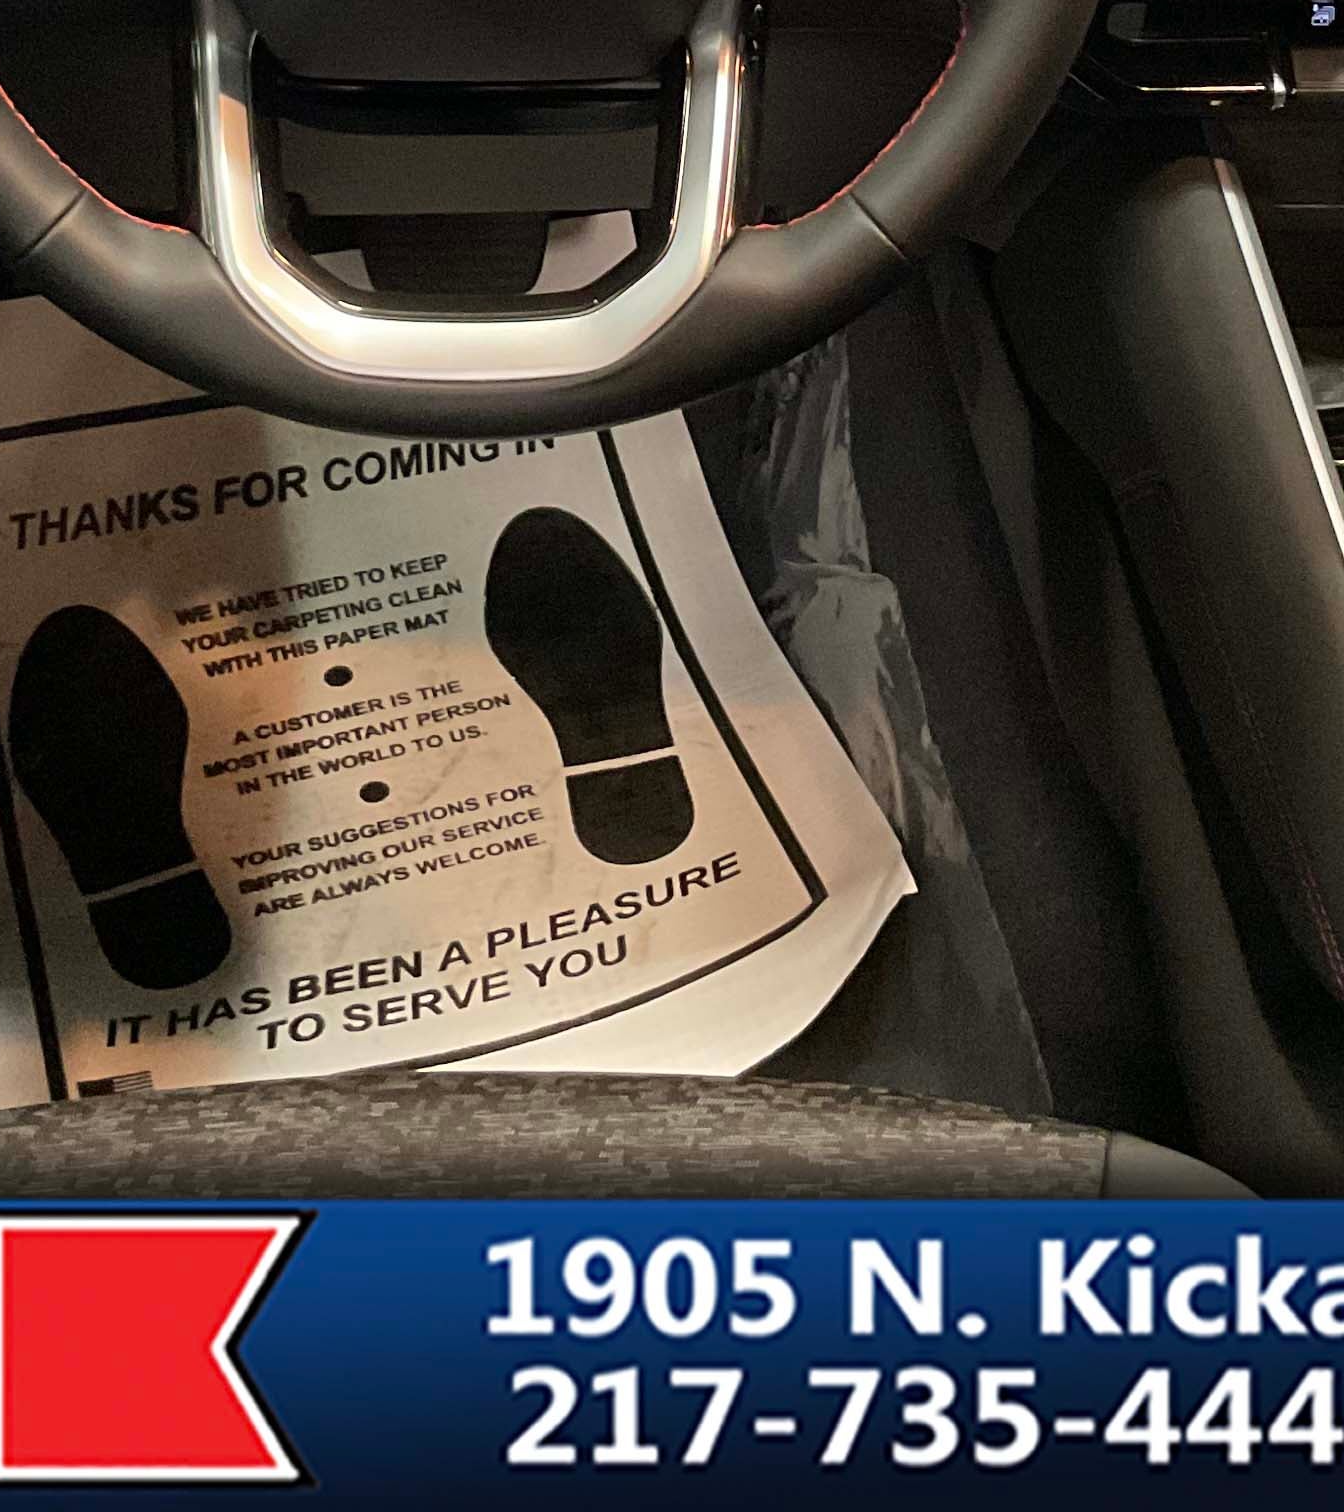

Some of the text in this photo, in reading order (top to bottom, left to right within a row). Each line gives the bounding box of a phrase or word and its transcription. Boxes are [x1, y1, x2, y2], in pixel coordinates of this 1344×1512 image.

[9, 483, 200, 550] THANKS
[214, 465, 309, 515] FOR
[323, 440, 500, 492] COMING
[176, 553, 448, 626] WE HAVE TRIED TO KEEP
[182, 579, 463, 653] YOUR CARPETING CLEAN
[203, 610, 450, 677] WITH THIS PAPER MAT
[203, 694, 511, 777] MOST IMPORTANT PERSON
[233, 681, 464, 745] A CUSTOMER IS THE
[236, 780, 260, 795] IN
[266, 766, 314, 788] THE
[318, 744, 406, 775] WORLD
[411, 734, 443, 752] TO
[231, 784, 536, 869] YOUR SUGGESTIONS FOR
[382, 834, 436, 860] OUR
[442, 808, 544, 842] SERVICE
[254, 892, 306, 917] ARE
[311, 866, 411, 905] ALWAYS
[105, 852, 742, 1047] IT HAS BEEN A PLEASURE
[256, 935, 630, 1051] TO SERVE YOU
